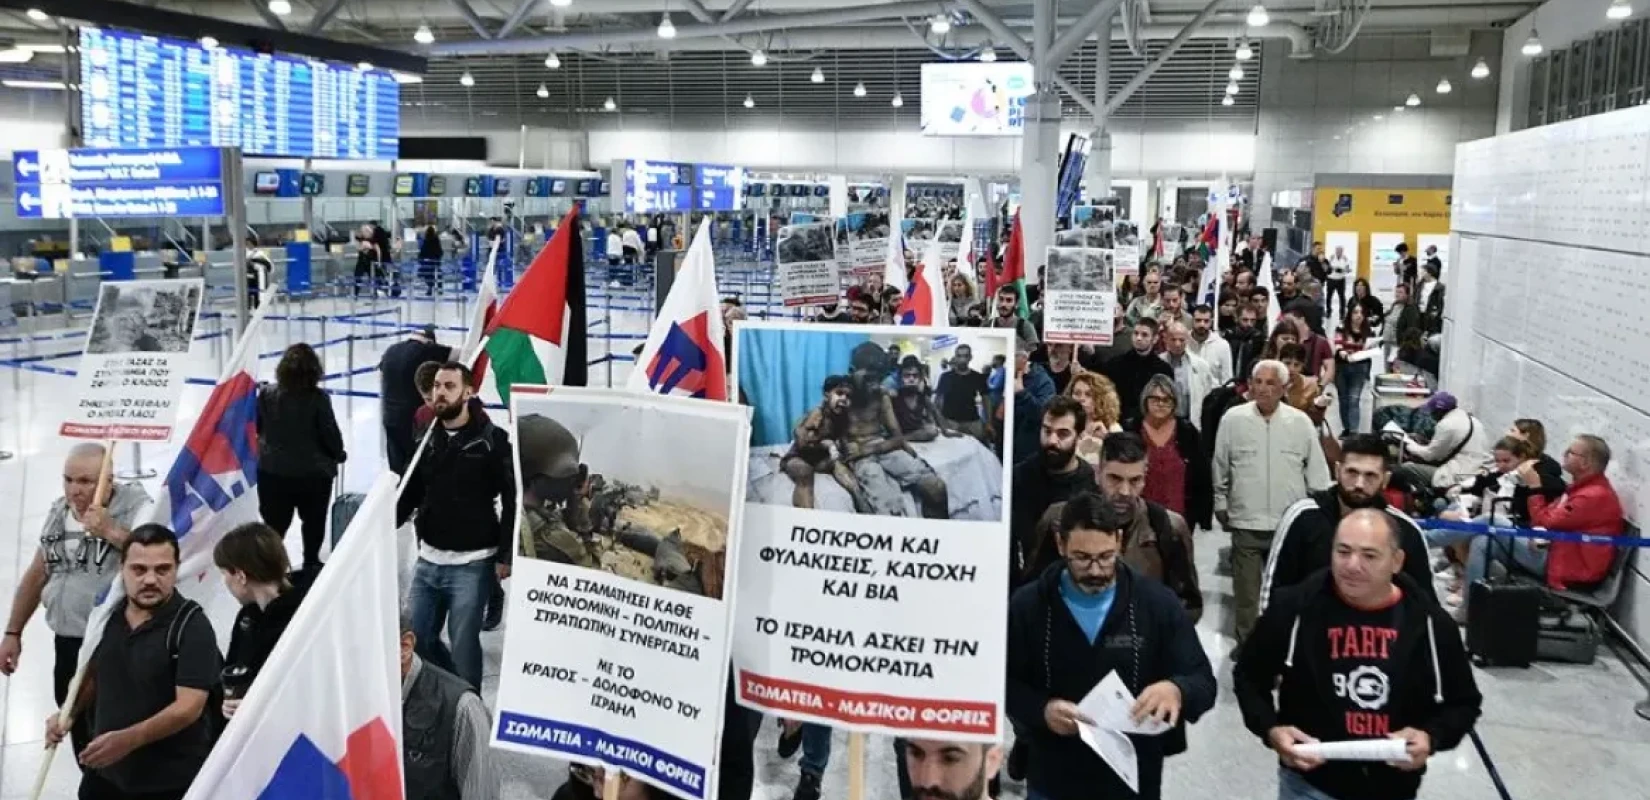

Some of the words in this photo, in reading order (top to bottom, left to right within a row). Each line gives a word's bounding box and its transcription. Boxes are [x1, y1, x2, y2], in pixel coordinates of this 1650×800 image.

[791, 526, 893, 552] ΠΟΓΚΡΟΜ
[901, 536, 939, 555] ΚΑΙ
[759, 546, 877, 578] ΦΥΛΑΚΙΣΕΙΣ,
[886, 560, 977, 582] ΚΑΤΟΧΗ
[546, 574, 569, 588] ΝΑ
[574, 578, 650, 608] ΣΤΑΜΑΤΗΣΕΙ
[654, 598, 693, 619] ΚΑΘΕ
[822, 579, 858, 598] ΚΑΙ
[865, 583, 899, 602] ΒΙΑ
[526, 589, 620, 619] ΟΙΚΟΝΟΜΙΚΗ
[633, 613, 700, 640] ΠΟΛΙΤΙΚΗ
[533, 608, 616, 638] ΣΤΡΑΤΙΩΤΙΚΗ
[619, 628, 700, 660] ΣΥΝΕΡΓΑΣΙΑ
[755, 616, 779, 635] ΤΟ
[784, 621, 855, 647] ΙΣΡΑΗΛ
[863, 632, 925, 653] ΑΣΚΕΙ
[934, 638, 979, 657] ΤΗΝ
[597, 658, 614, 675] ΜΕ
[618, 665, 635, 680] ΤΟ
[790, 646, 934, 679] ΤΡΟΜΟΚΡΑΤΙΑ
[522, 662, 577, 683] ΚΡΑΤΟΣ
[592, 676, 673, 710] ΔΟΛΟΦΟΝΟ
[677, 701, 701, 720] ΤΟΥ
[591, 694, 636, 719] ΙΣΡΑΗΛ
[746, 680, 823, 709] ΣΩΜΑΤΕΙΑ
[838, 699, 916, 721] ΜΑΖΙΚΟΙ
[920, 709, 991, 727] ΦΟΡΕΙΣ
[504, 720, 582, 748] ΣΩΜΑΤΕΙΑ
[595, 739, 653, 768] ΜΑΖΙΚΟΙ
[655, 760, 702, 789] ΦΟΡΕΙΣ
